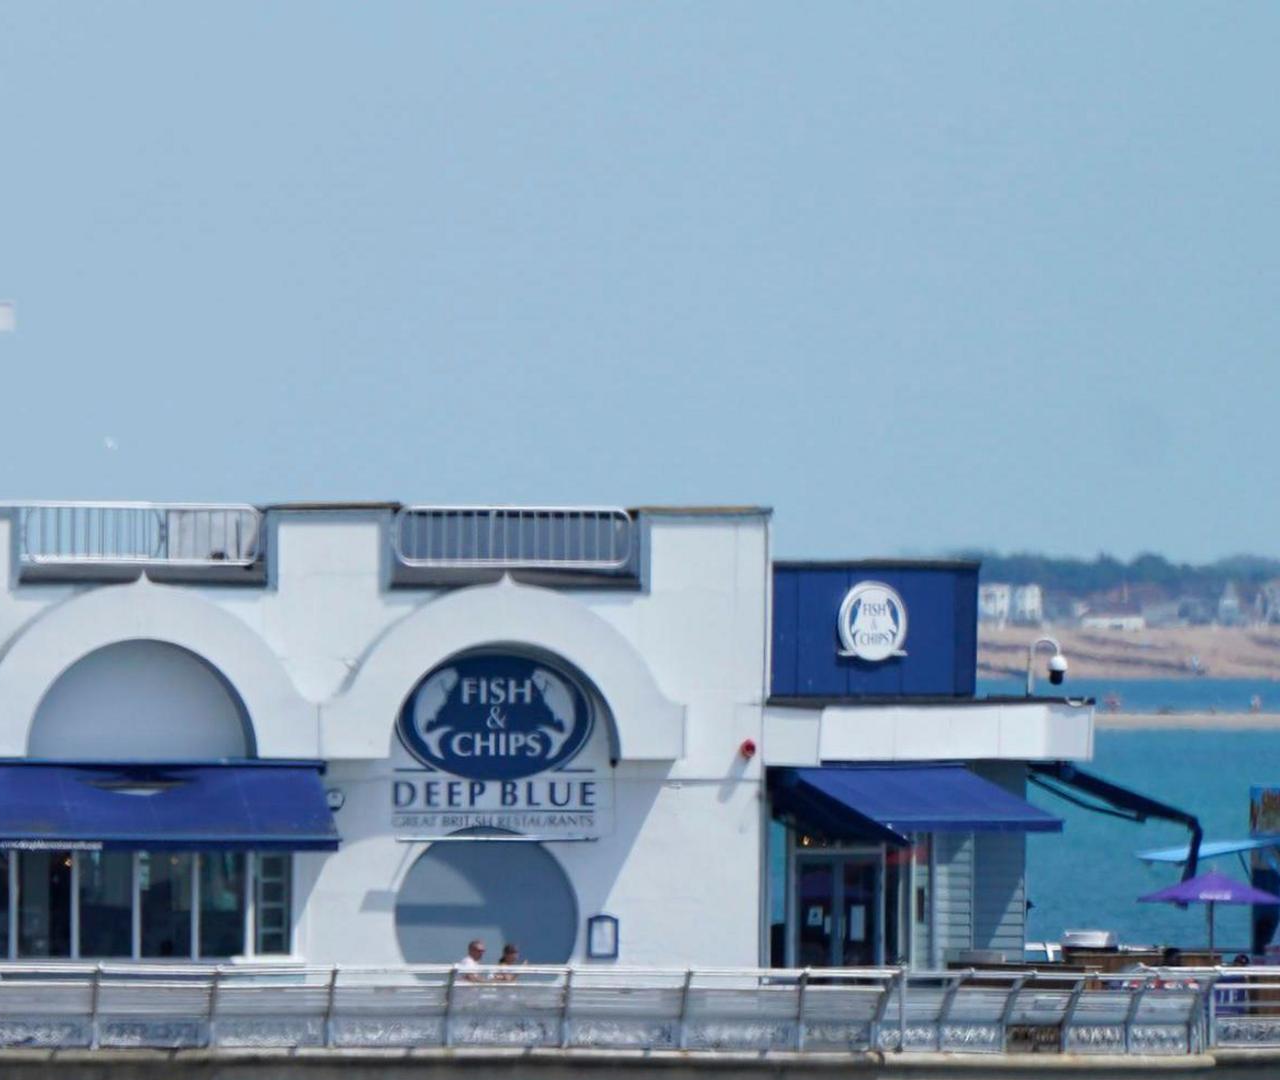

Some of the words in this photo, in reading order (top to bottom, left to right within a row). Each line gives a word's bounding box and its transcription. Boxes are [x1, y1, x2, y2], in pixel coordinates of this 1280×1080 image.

[863, 604, 886, 616] FISH
[861, 633, 889, 645] CHIPS
[461, 678, 532, 705] FISH
[486, 705, 507, 730] &
[451, 731, 542, 758] CHIPS
[393, 782, 487, 807] DEEP
[502, 782, 596, 807] BLUE
[392, 815, 437, 827] GREAT
[442, 815, 493, 827] BRITSH
[497, 815, 594, 827] RESTAURANTS
